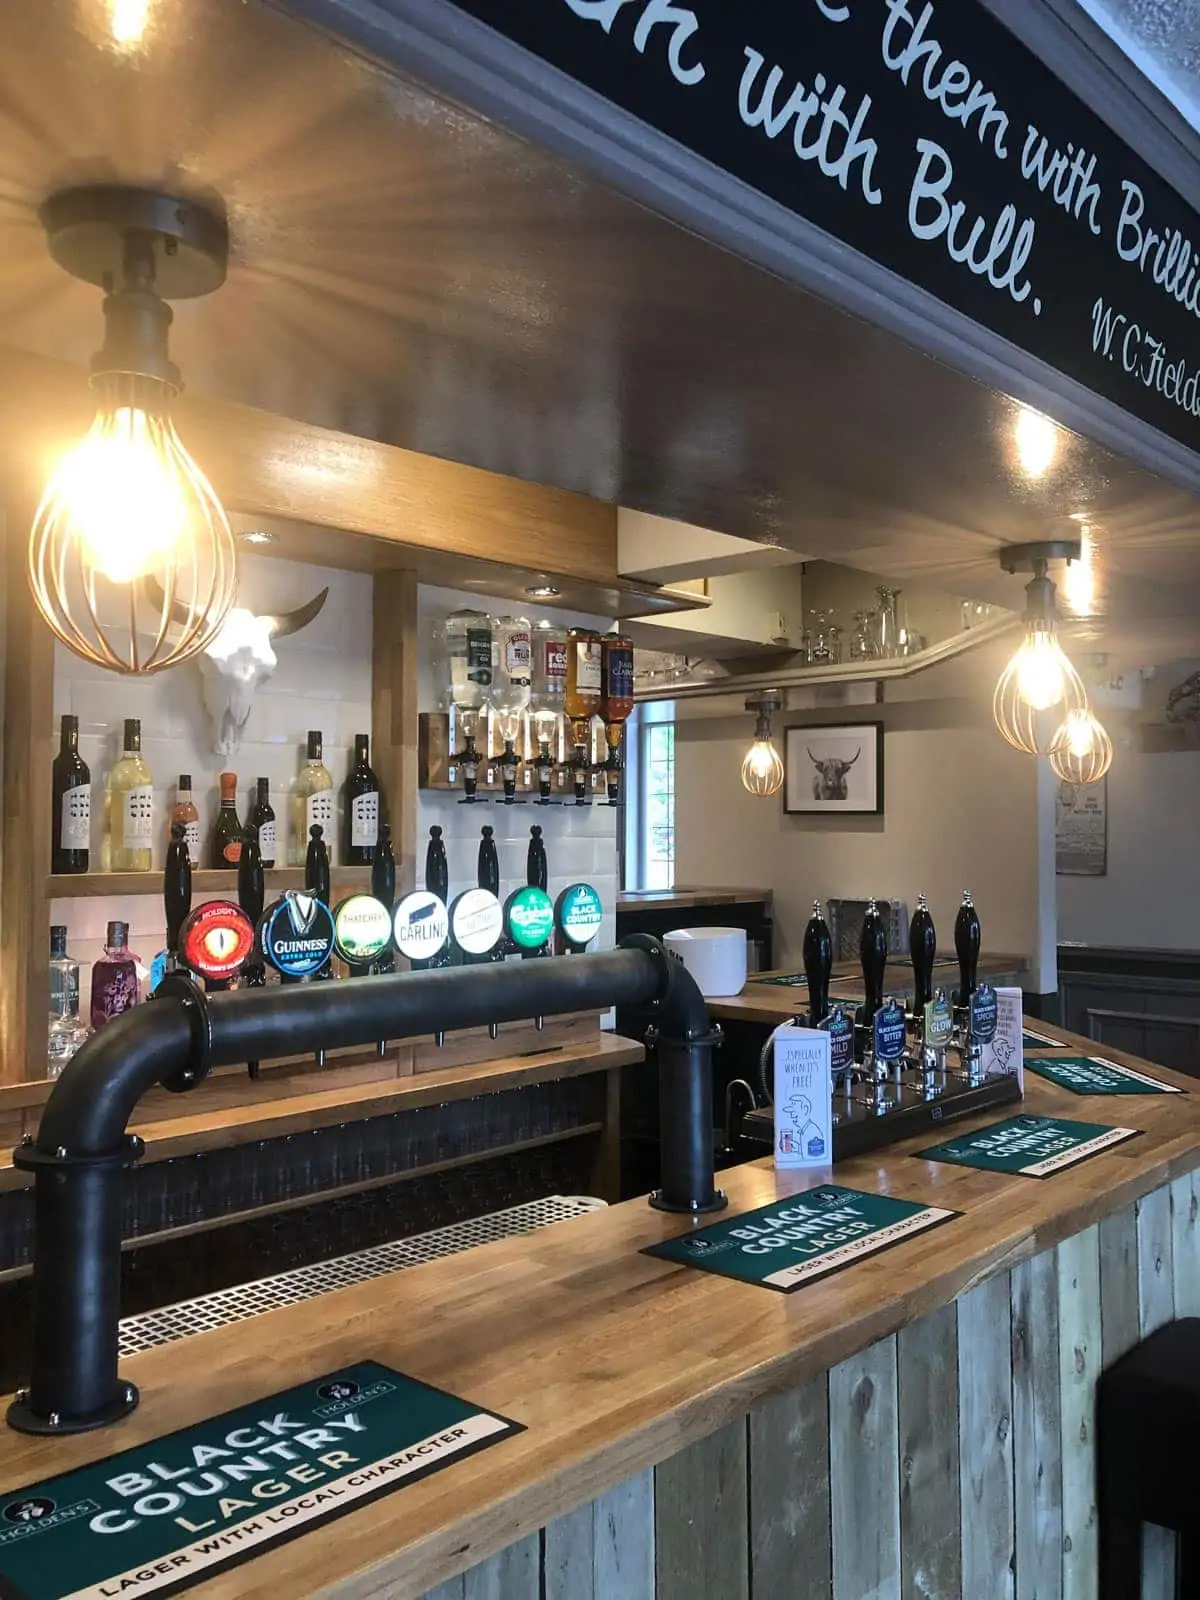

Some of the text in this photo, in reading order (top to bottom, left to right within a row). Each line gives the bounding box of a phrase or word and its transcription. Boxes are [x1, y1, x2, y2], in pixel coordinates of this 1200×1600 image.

[882, 0, 1009, 159] them
[1020, 124, 1101, 236] with
[738, 45, 882, 205] with
[908, 138, 1041, 316] Bull.
[273, 937, 329, 954] GUINNESS
[400, 921, 446, 942] CARLING
[883, 1030, 903, 1043] BITTER
[930, 1018, 952, 1034] GLOW
[970, 1126, 1032, 1149] BLACK
[987, 1126, 1067, 1158] COUNTRY
[1026, 1136, 1081, 1157] LAGER
[727, 1203, 822, 1241] BLACK
[741, 1203, 866, 1256] COUNTRY
[791, 1220, 876, 1255] LAGER
[786, 1259, 822, 1277] LAGER
[104, 1411, 304, 1498] BLACK
[89, 1412, 370, 1536] COUNTRY
[173, 1450, 360, 1534] LAGER
[98, 1426, 470, 1598] LAGER WITH LOCAL CHARACTER
